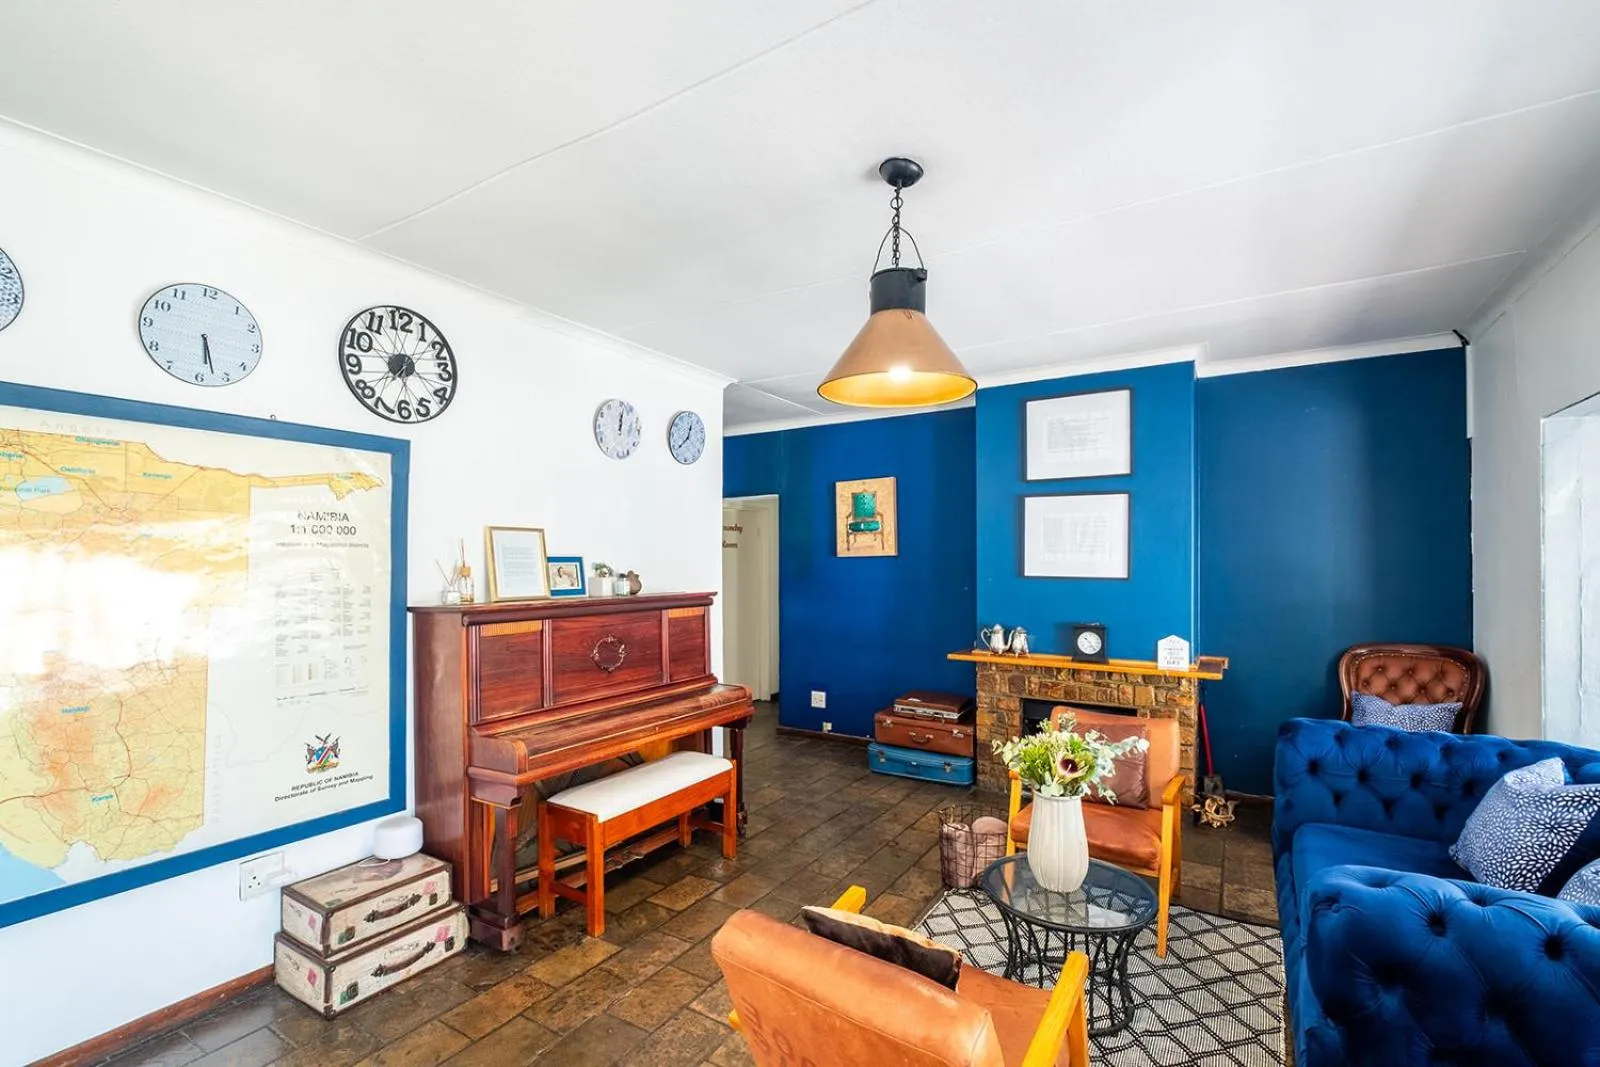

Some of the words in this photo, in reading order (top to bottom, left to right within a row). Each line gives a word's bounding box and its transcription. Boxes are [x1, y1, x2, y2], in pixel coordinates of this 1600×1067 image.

[173, 288, 187, 301] 11
[201, 287, 218, 300] 12
[154, 299, 172, 313] 10
[234, 305, 240, 316] 1
[143, 316, 154, 328] 9
[246, 323, 256, 334] 2
[366, 311, 384, 336] 11
[389, 309, 413, 334] 12
[419, 322, 427, 343] 1
[149, 340, 159, 352] 8
[347, 327, 373, 353] 10
[250, 343, 260, 354] 3
[431, 341, 447, 361] 2
[345, 353, 362, 375] 9
[194, 372, 205, 383] 6
[437, 362, 452, 382] 3
[355, 379, 376, 400] 8
[433, 386, 448, 405] 4
[373, 396, 395, 414] 7
[397, 399, 412, 420] 6
[415, 397, 431, 418] 5
[297, 511, 350, 522] NAMIBIA
[336, 525, 357, 536] 000
[291, 779, 323, 792] REPUBLIC
[274, 789, 309, 803] Directorate
